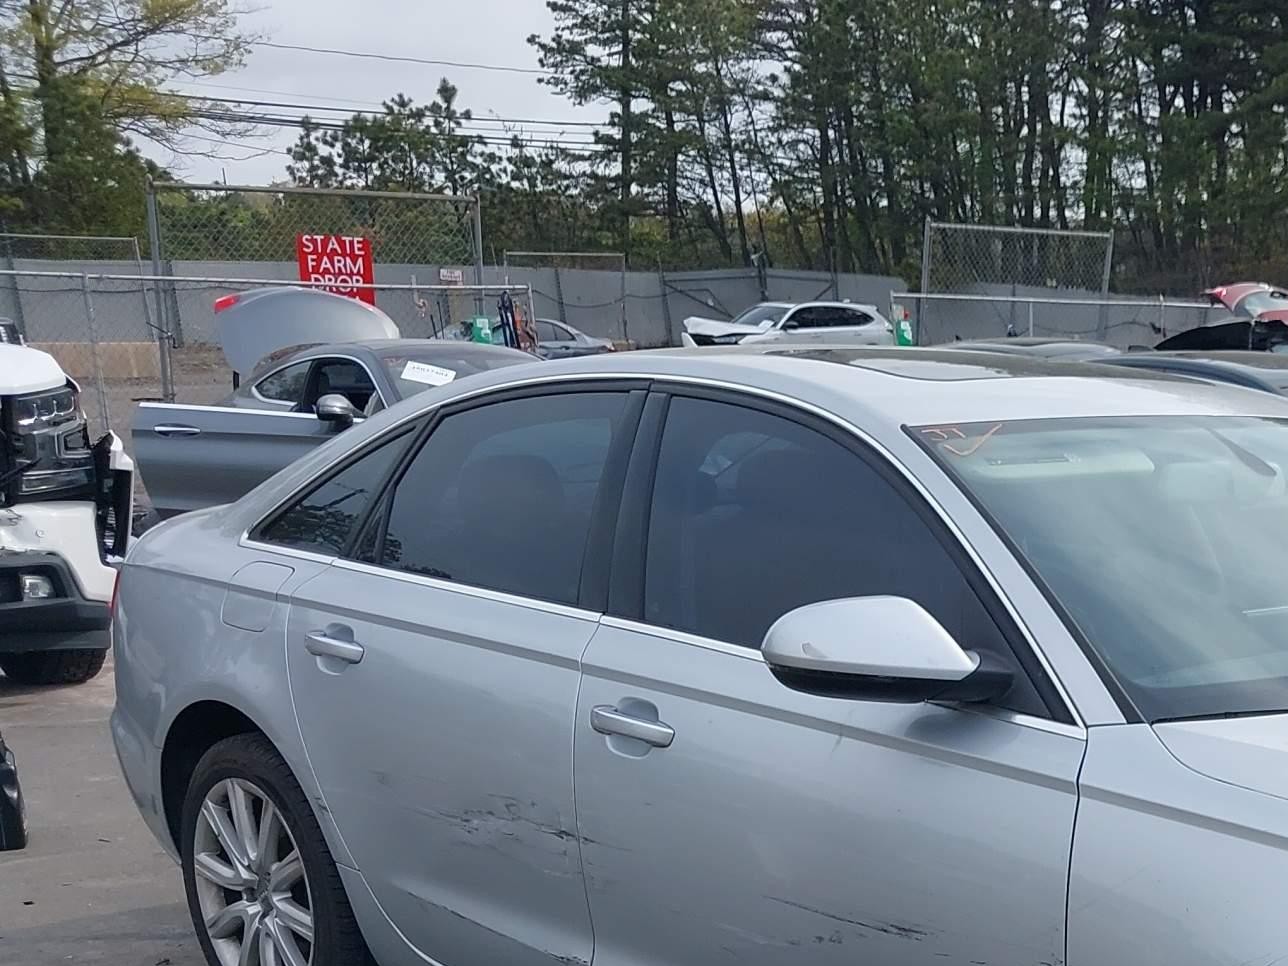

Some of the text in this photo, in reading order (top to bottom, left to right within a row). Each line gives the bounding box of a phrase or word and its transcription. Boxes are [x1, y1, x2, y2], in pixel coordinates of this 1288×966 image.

[302, 234, 365, 255] STATE
[307, 254, 364, 275] FARM
[310, 274, 364, 293] DROP
